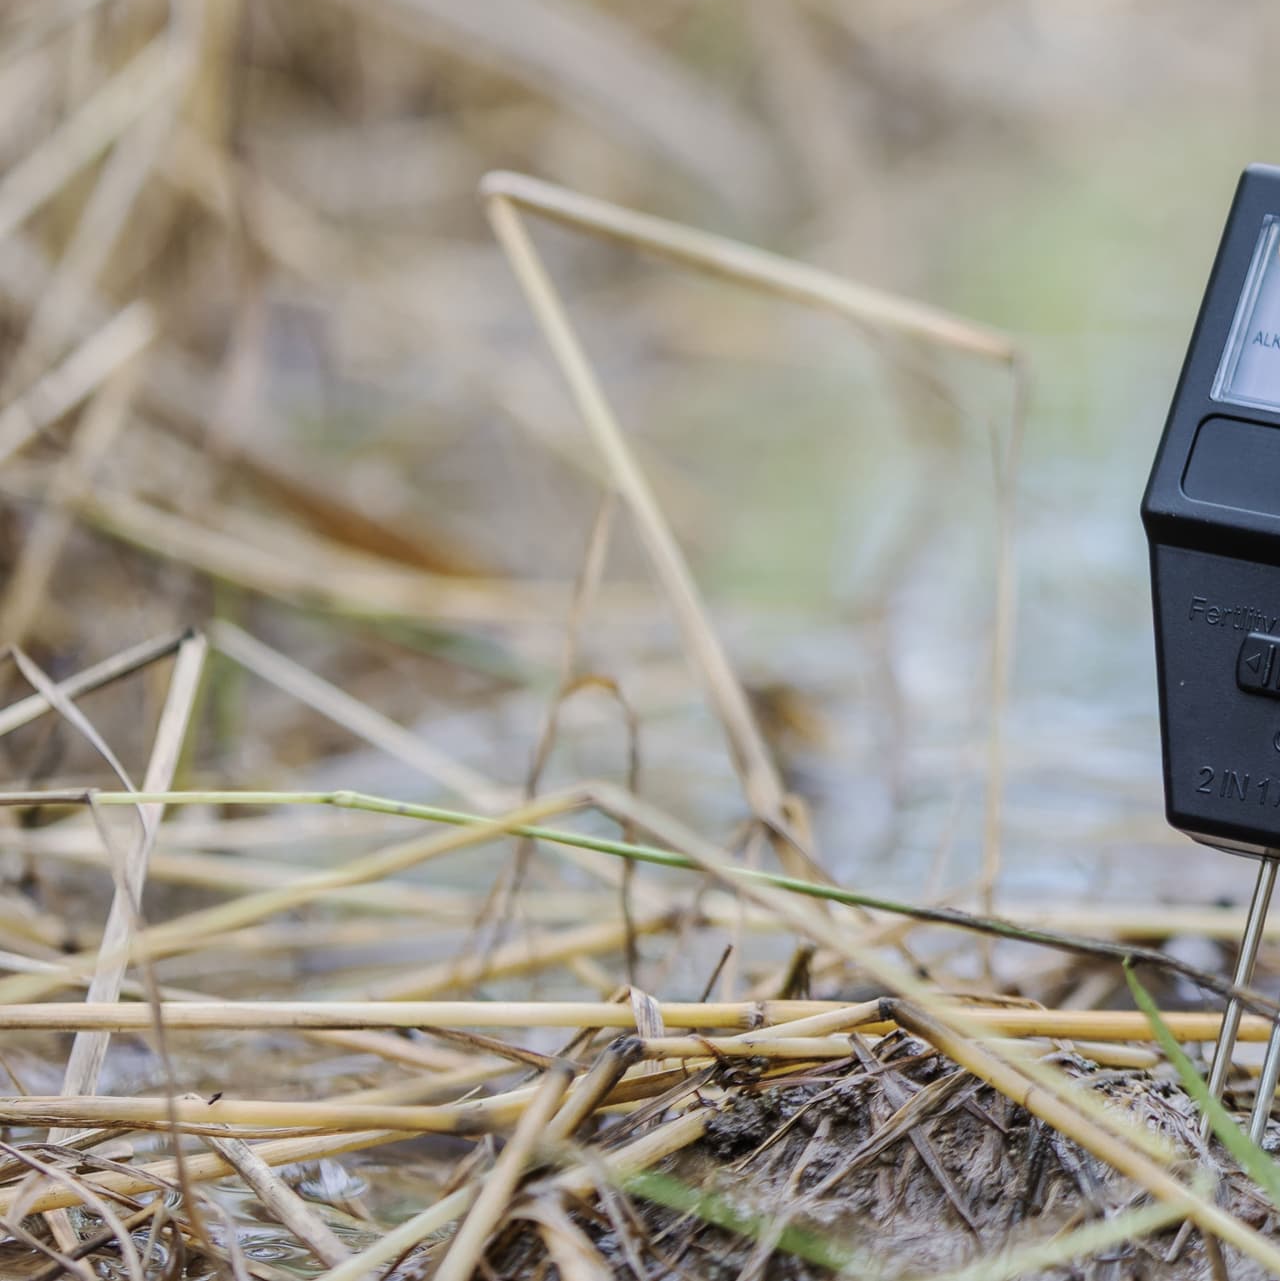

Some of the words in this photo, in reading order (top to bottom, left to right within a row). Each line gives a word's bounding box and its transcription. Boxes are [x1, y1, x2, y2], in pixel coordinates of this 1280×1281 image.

[1188, 596, 1279, 634] Fertility
[1196, 766, 1213, 794] 2
[1220, 768, 1250, 801] IN
[1257, 777, 1271, 806] 1
